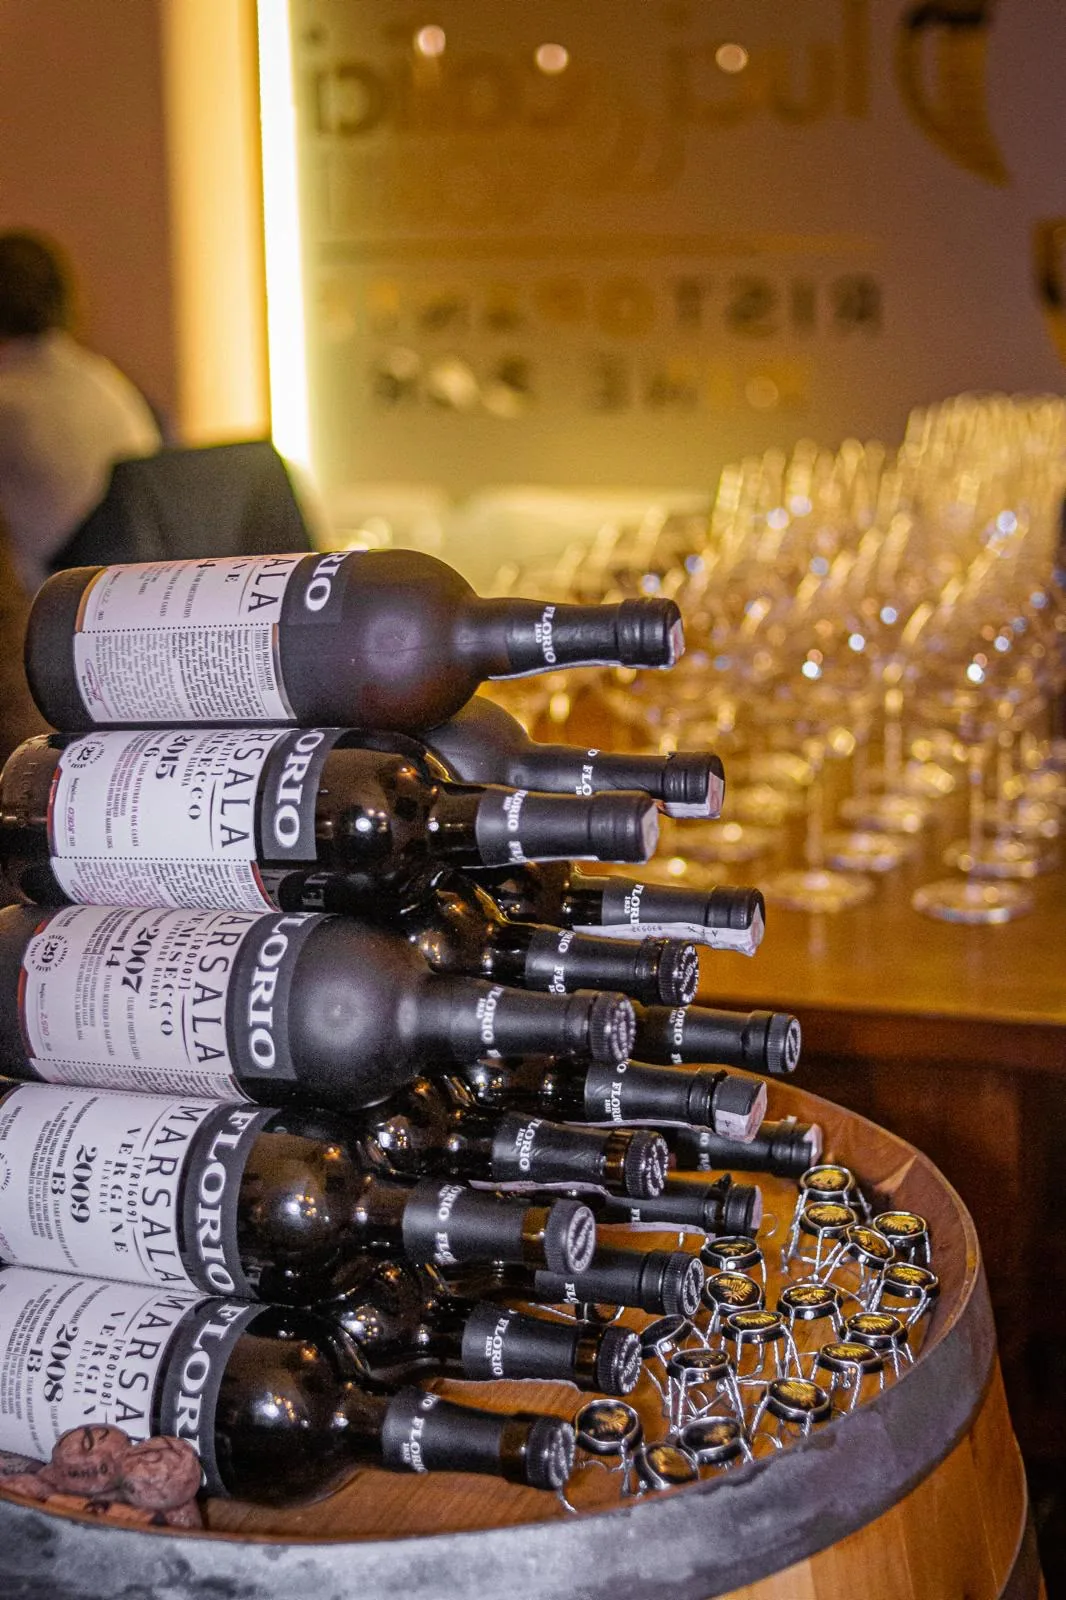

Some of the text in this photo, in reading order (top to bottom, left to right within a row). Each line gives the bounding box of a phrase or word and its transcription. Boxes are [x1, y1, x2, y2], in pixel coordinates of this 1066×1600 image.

[535, 624, 543, 643] 1833
[542, 606, 556, 663] FLORIO
[144, 747, 160, 757] 6
[156, 735, 195, 780] 2015
[181, 757, 198, 787] RISERVA
[273, 727, 324, 848] ORIO
[41, 942, 59, 963] 29
[105, 945, 125, 968] 14
[121, 927, 160, 994] 2007
[160, 911, 210, 1036] SEMISECCO
[149, 968, 162, 1009] RISERVA
[248, 914, 314, 1069] LORIO
[480, 986, 505, 1043] FLORIO
[519, 1118, 543, 1171] FLORIO
[51, 1170, 66, 1195] 13
[70, 1144, 98, 1224] 2009
[98, 1160, 113, 1214] RISERVA
[110, 1127, 142, 1253] VERGINE
[126, 1156, 145, 1224] [VR1609]
[141, 1105, 208, 1283] MARSALA
[197, 1110, 258, 1292] FLORIO
[27, 1349, 43, 1372] 13
[43, 1325, 80, 1403] 2008
[73, 1340, 92, 1394] RISERVA
[114, 1295, 196, 1445] MARSA
[485, 1336, 493, 1357] 1833
[491, 1317, 510, 1375] FLORIO
